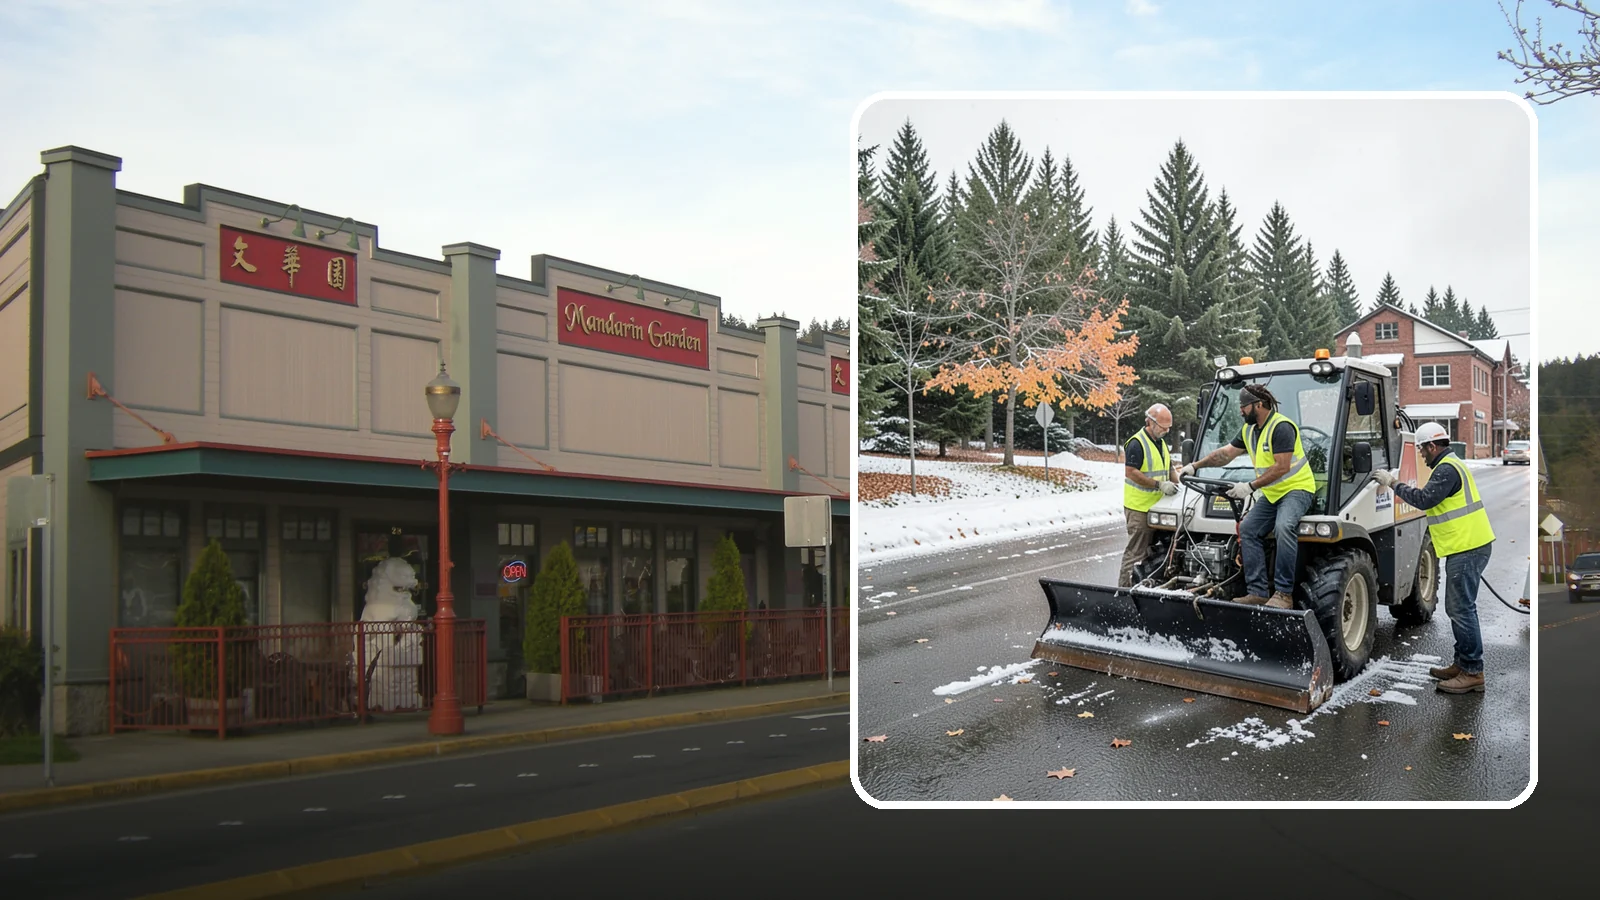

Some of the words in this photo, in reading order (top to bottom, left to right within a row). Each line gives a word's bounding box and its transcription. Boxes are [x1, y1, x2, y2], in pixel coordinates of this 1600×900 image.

[230, 235, 346, 291] 文華園
[564, 302, 644, 341] Mandarin
[648, 320, 702, 352] Garden
[503, 565, 527, 578] OPEN
